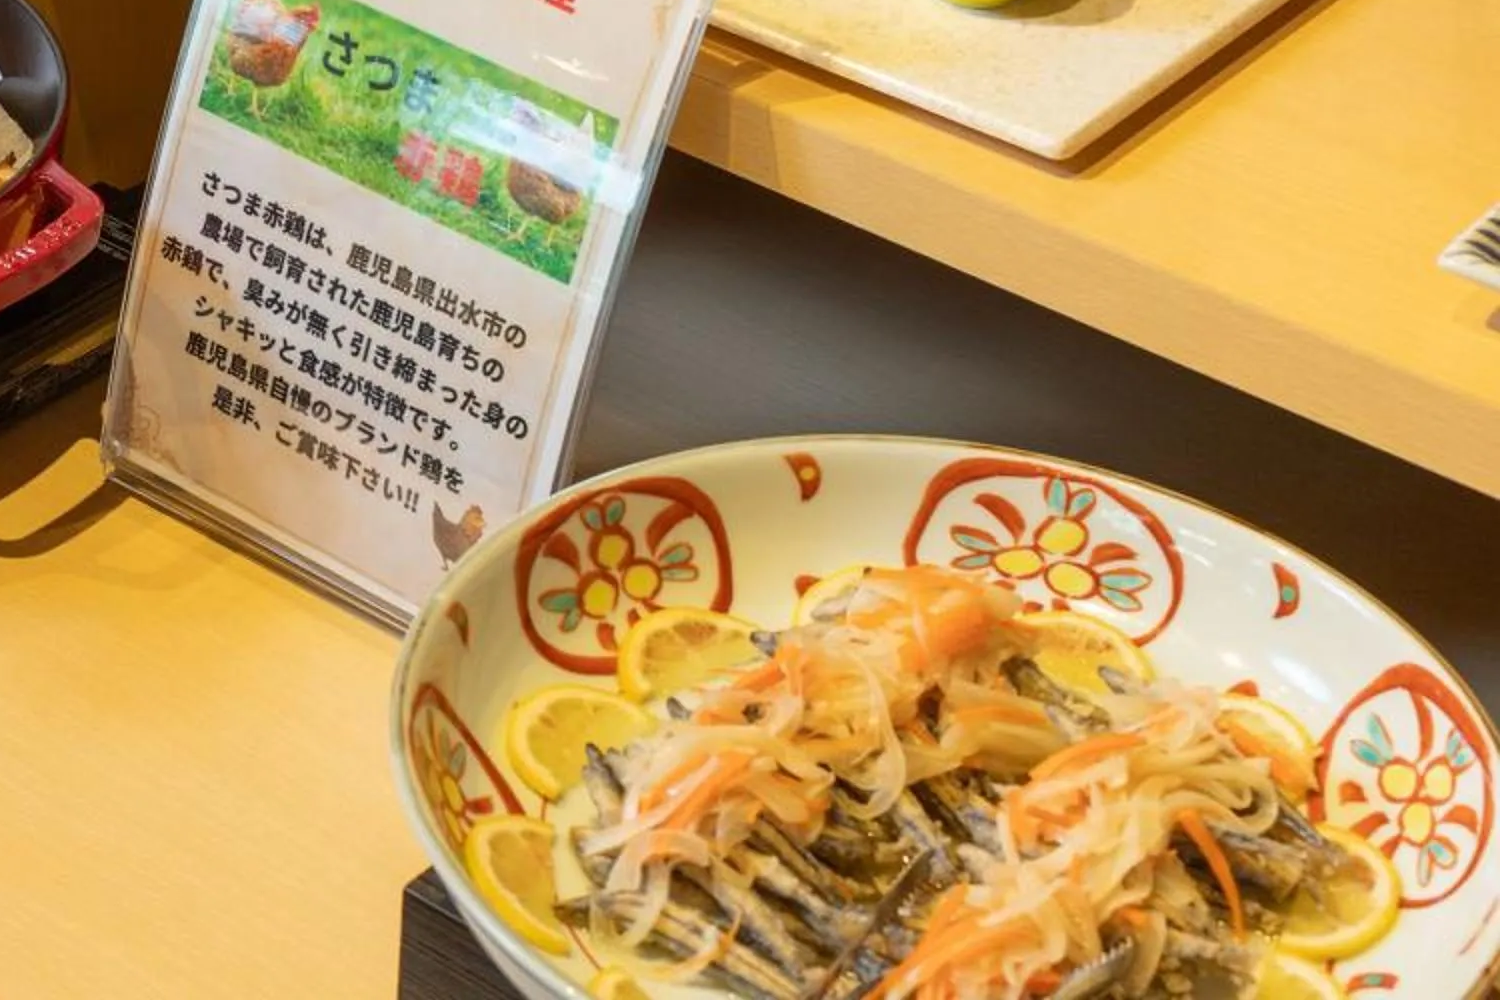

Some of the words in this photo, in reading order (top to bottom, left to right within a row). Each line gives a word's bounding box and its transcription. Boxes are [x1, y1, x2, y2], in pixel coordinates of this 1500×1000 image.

[322, 31, 441, 115] さつま
[161, 236, 529, 441] 赤鶏で、臭みが無く引き締まった身の
[199, 212, 506, 384] 農場で飼育された鹿児島育ちの
[201, 171, 528, 351] さつま赤鶏は、鹿児島県出水市の
[184, 330, 464, 495] 鹿児島県自慢のブランド鶏を
[194, 295, 460, 452] シャキッと食感が特徴です。
